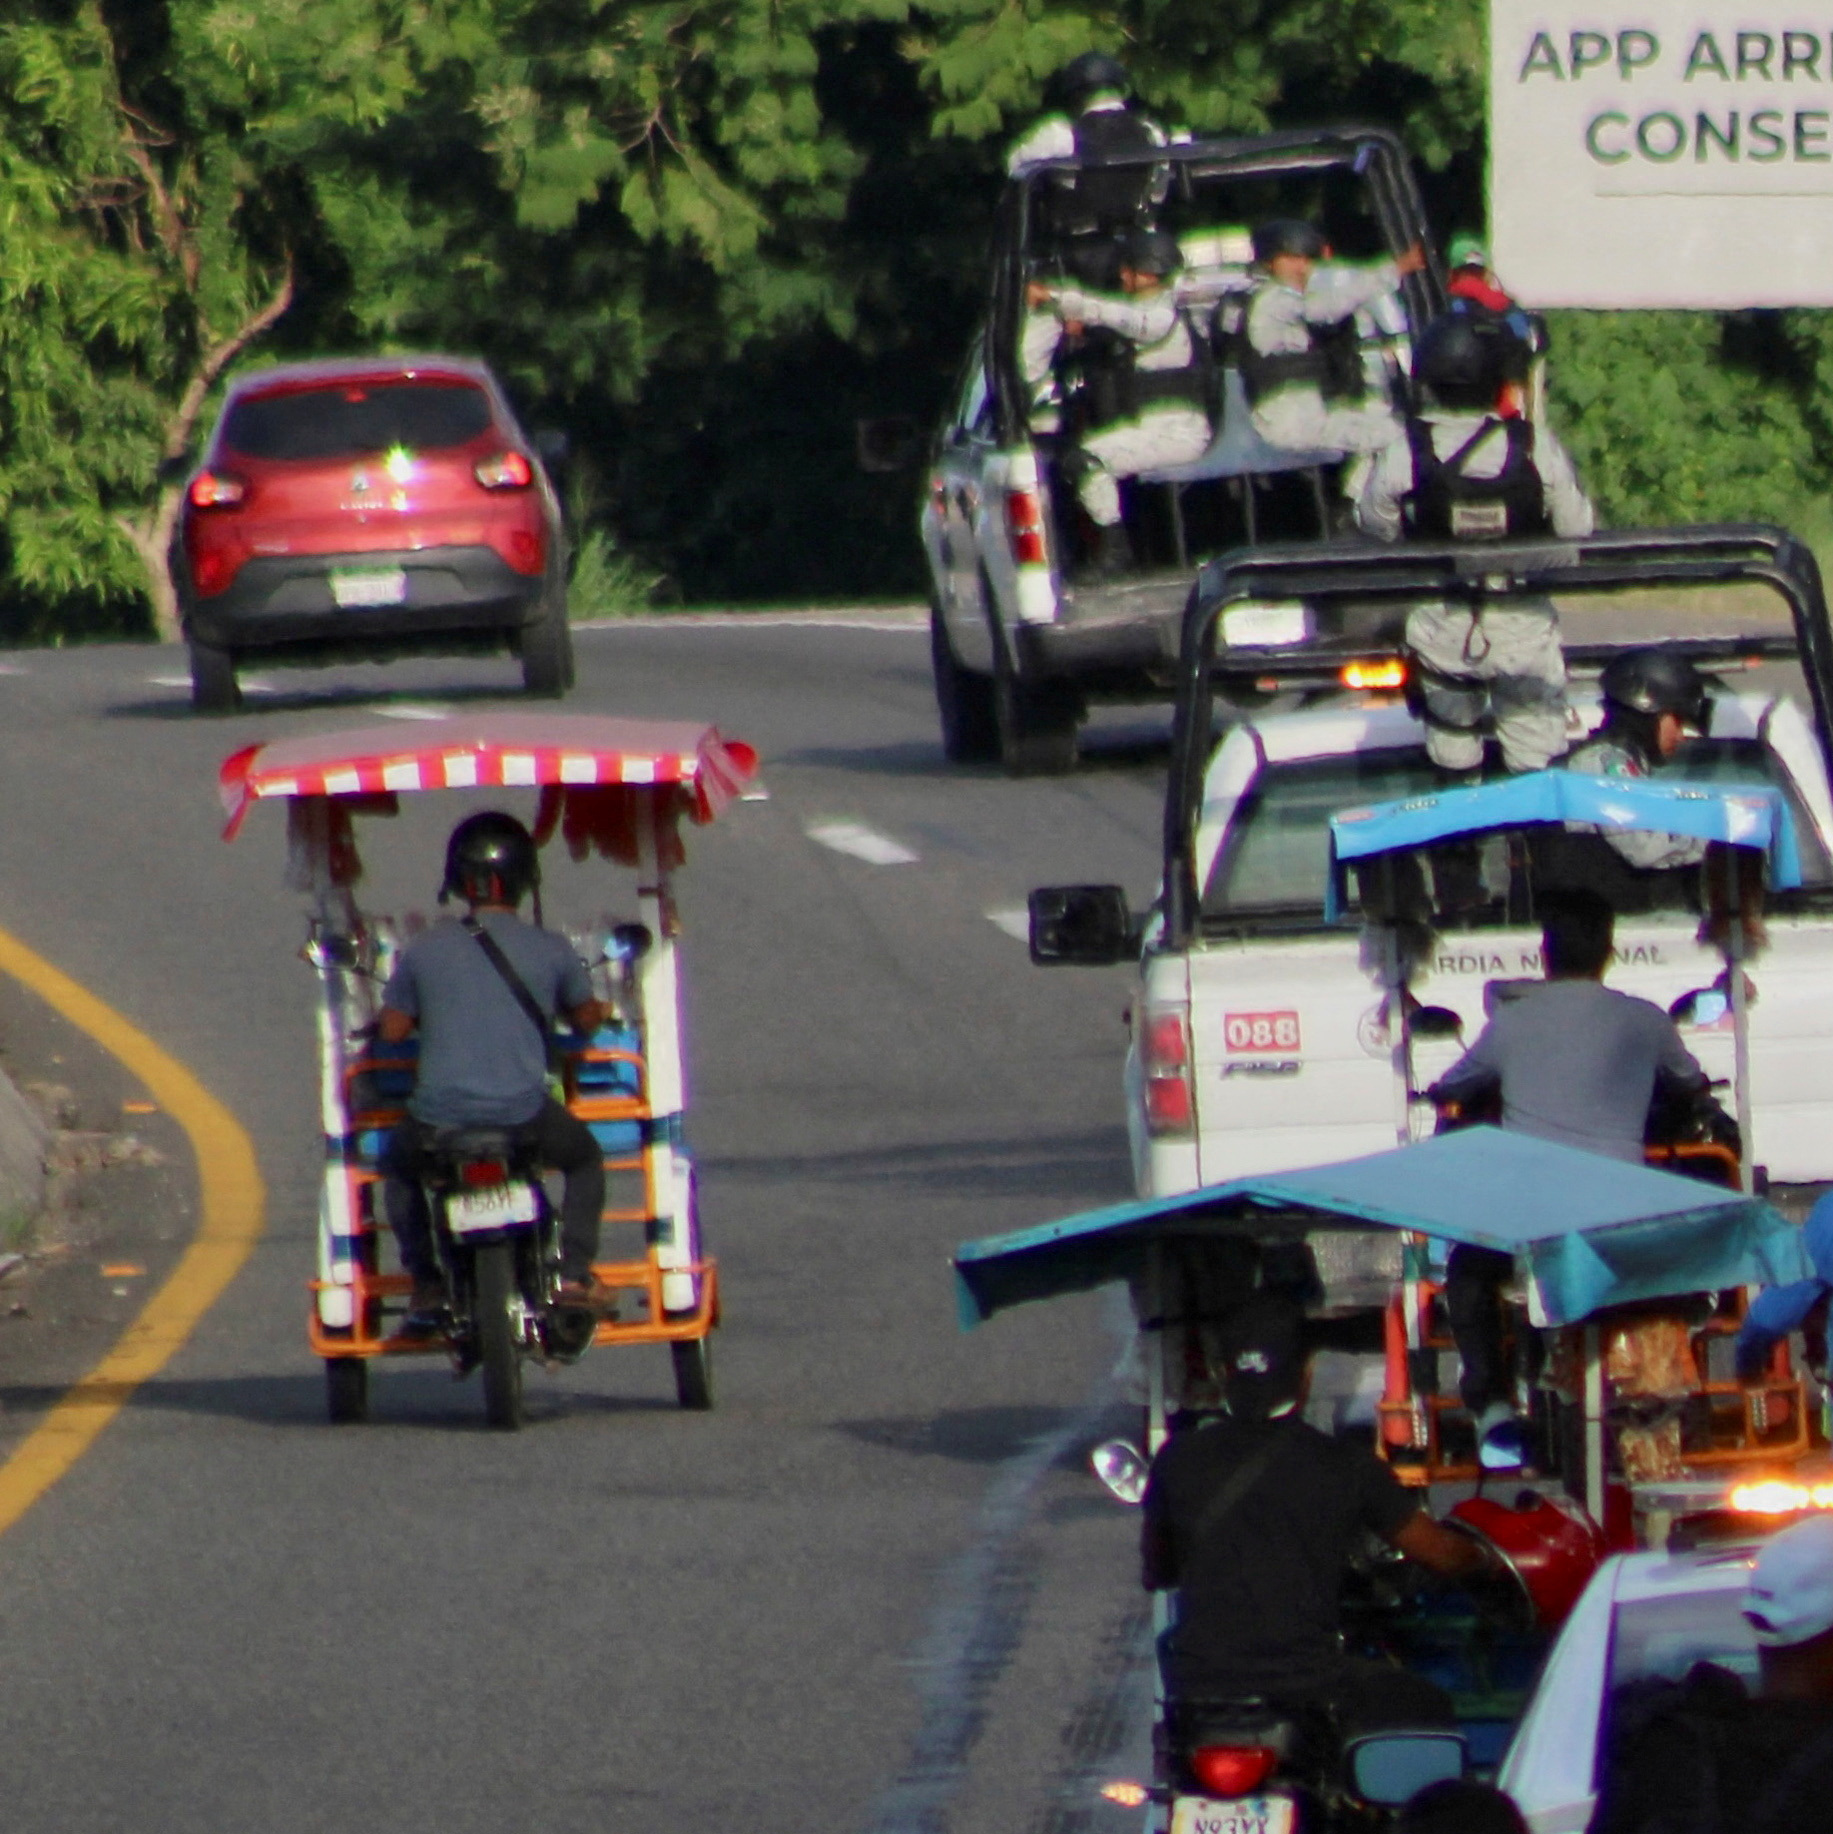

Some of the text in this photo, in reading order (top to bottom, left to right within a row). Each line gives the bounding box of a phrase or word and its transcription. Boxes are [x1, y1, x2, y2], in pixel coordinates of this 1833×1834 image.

[1518, 29, 1660, 83] APP
[1433, 953, 1507, 976] RDIA
[1227, 1017, 1298, 1048] 088
